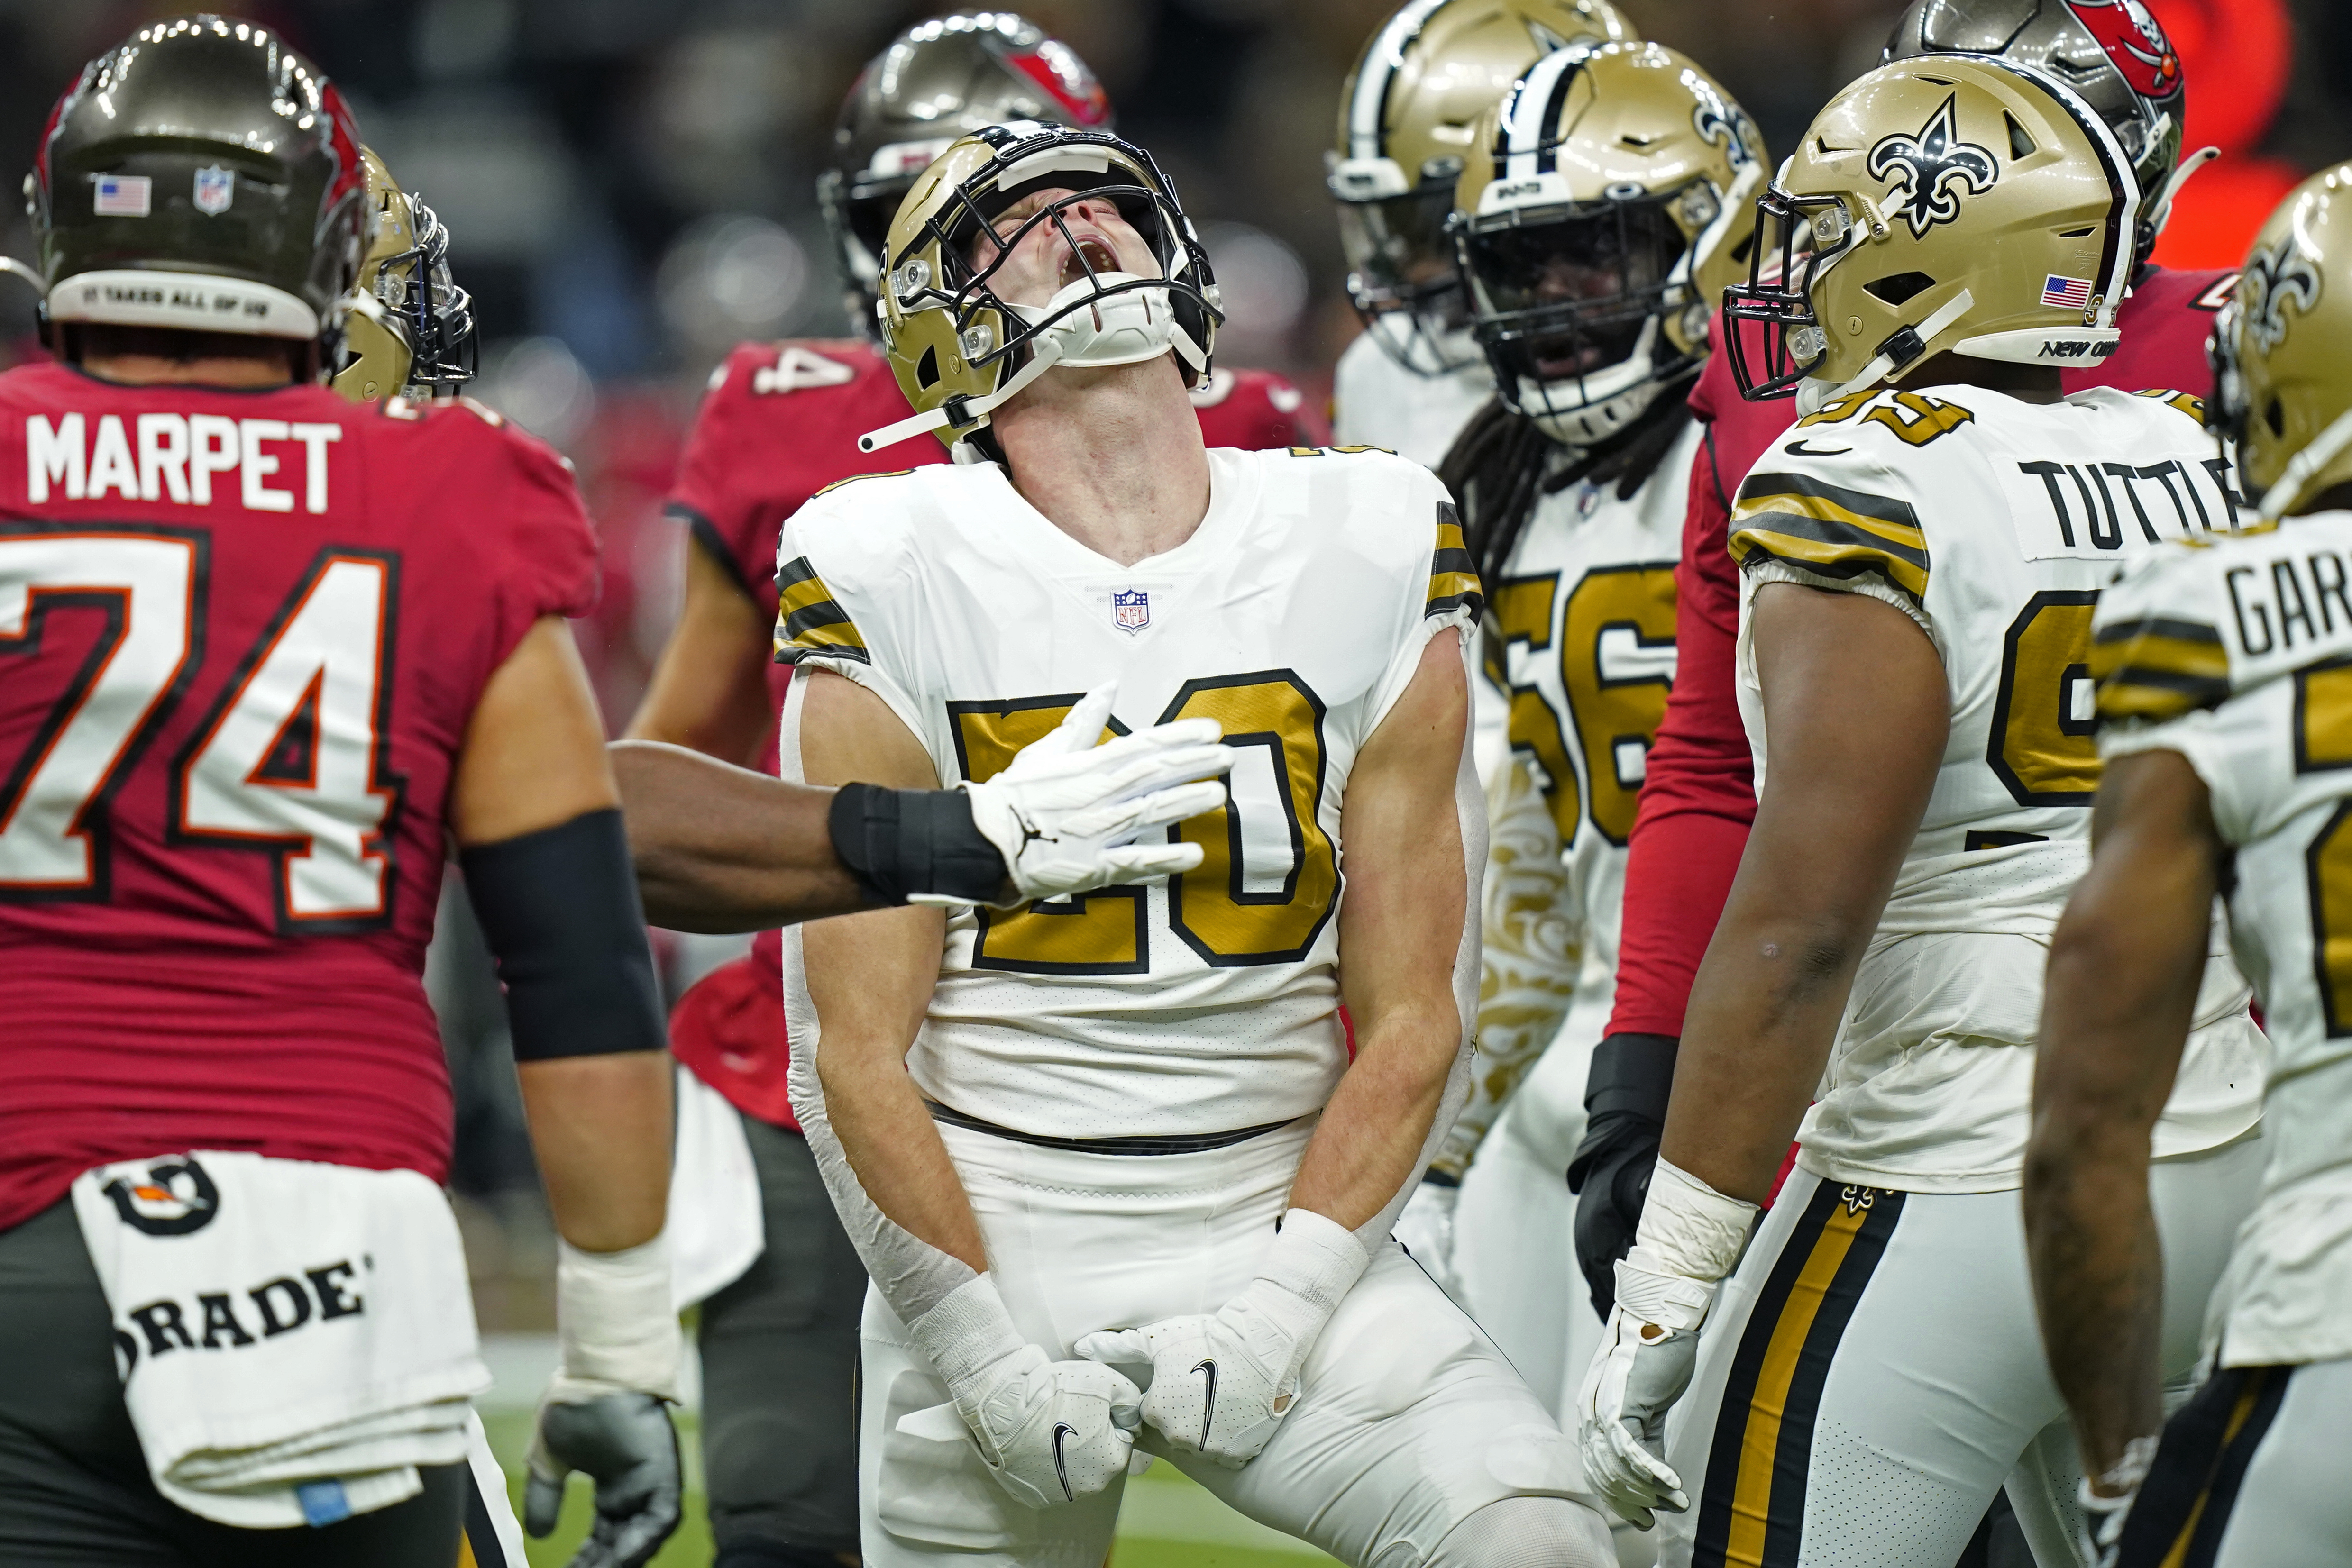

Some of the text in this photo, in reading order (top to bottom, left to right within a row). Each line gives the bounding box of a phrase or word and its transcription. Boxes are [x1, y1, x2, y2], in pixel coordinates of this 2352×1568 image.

[2037, 341, 2091, 357] NEW
[26, 411, 342, 514] MARPET
[1118, 607, 1146, 625] NFL
[2226, 550, 2352, 656] GAR
[0, 519, 409, 934] 74
